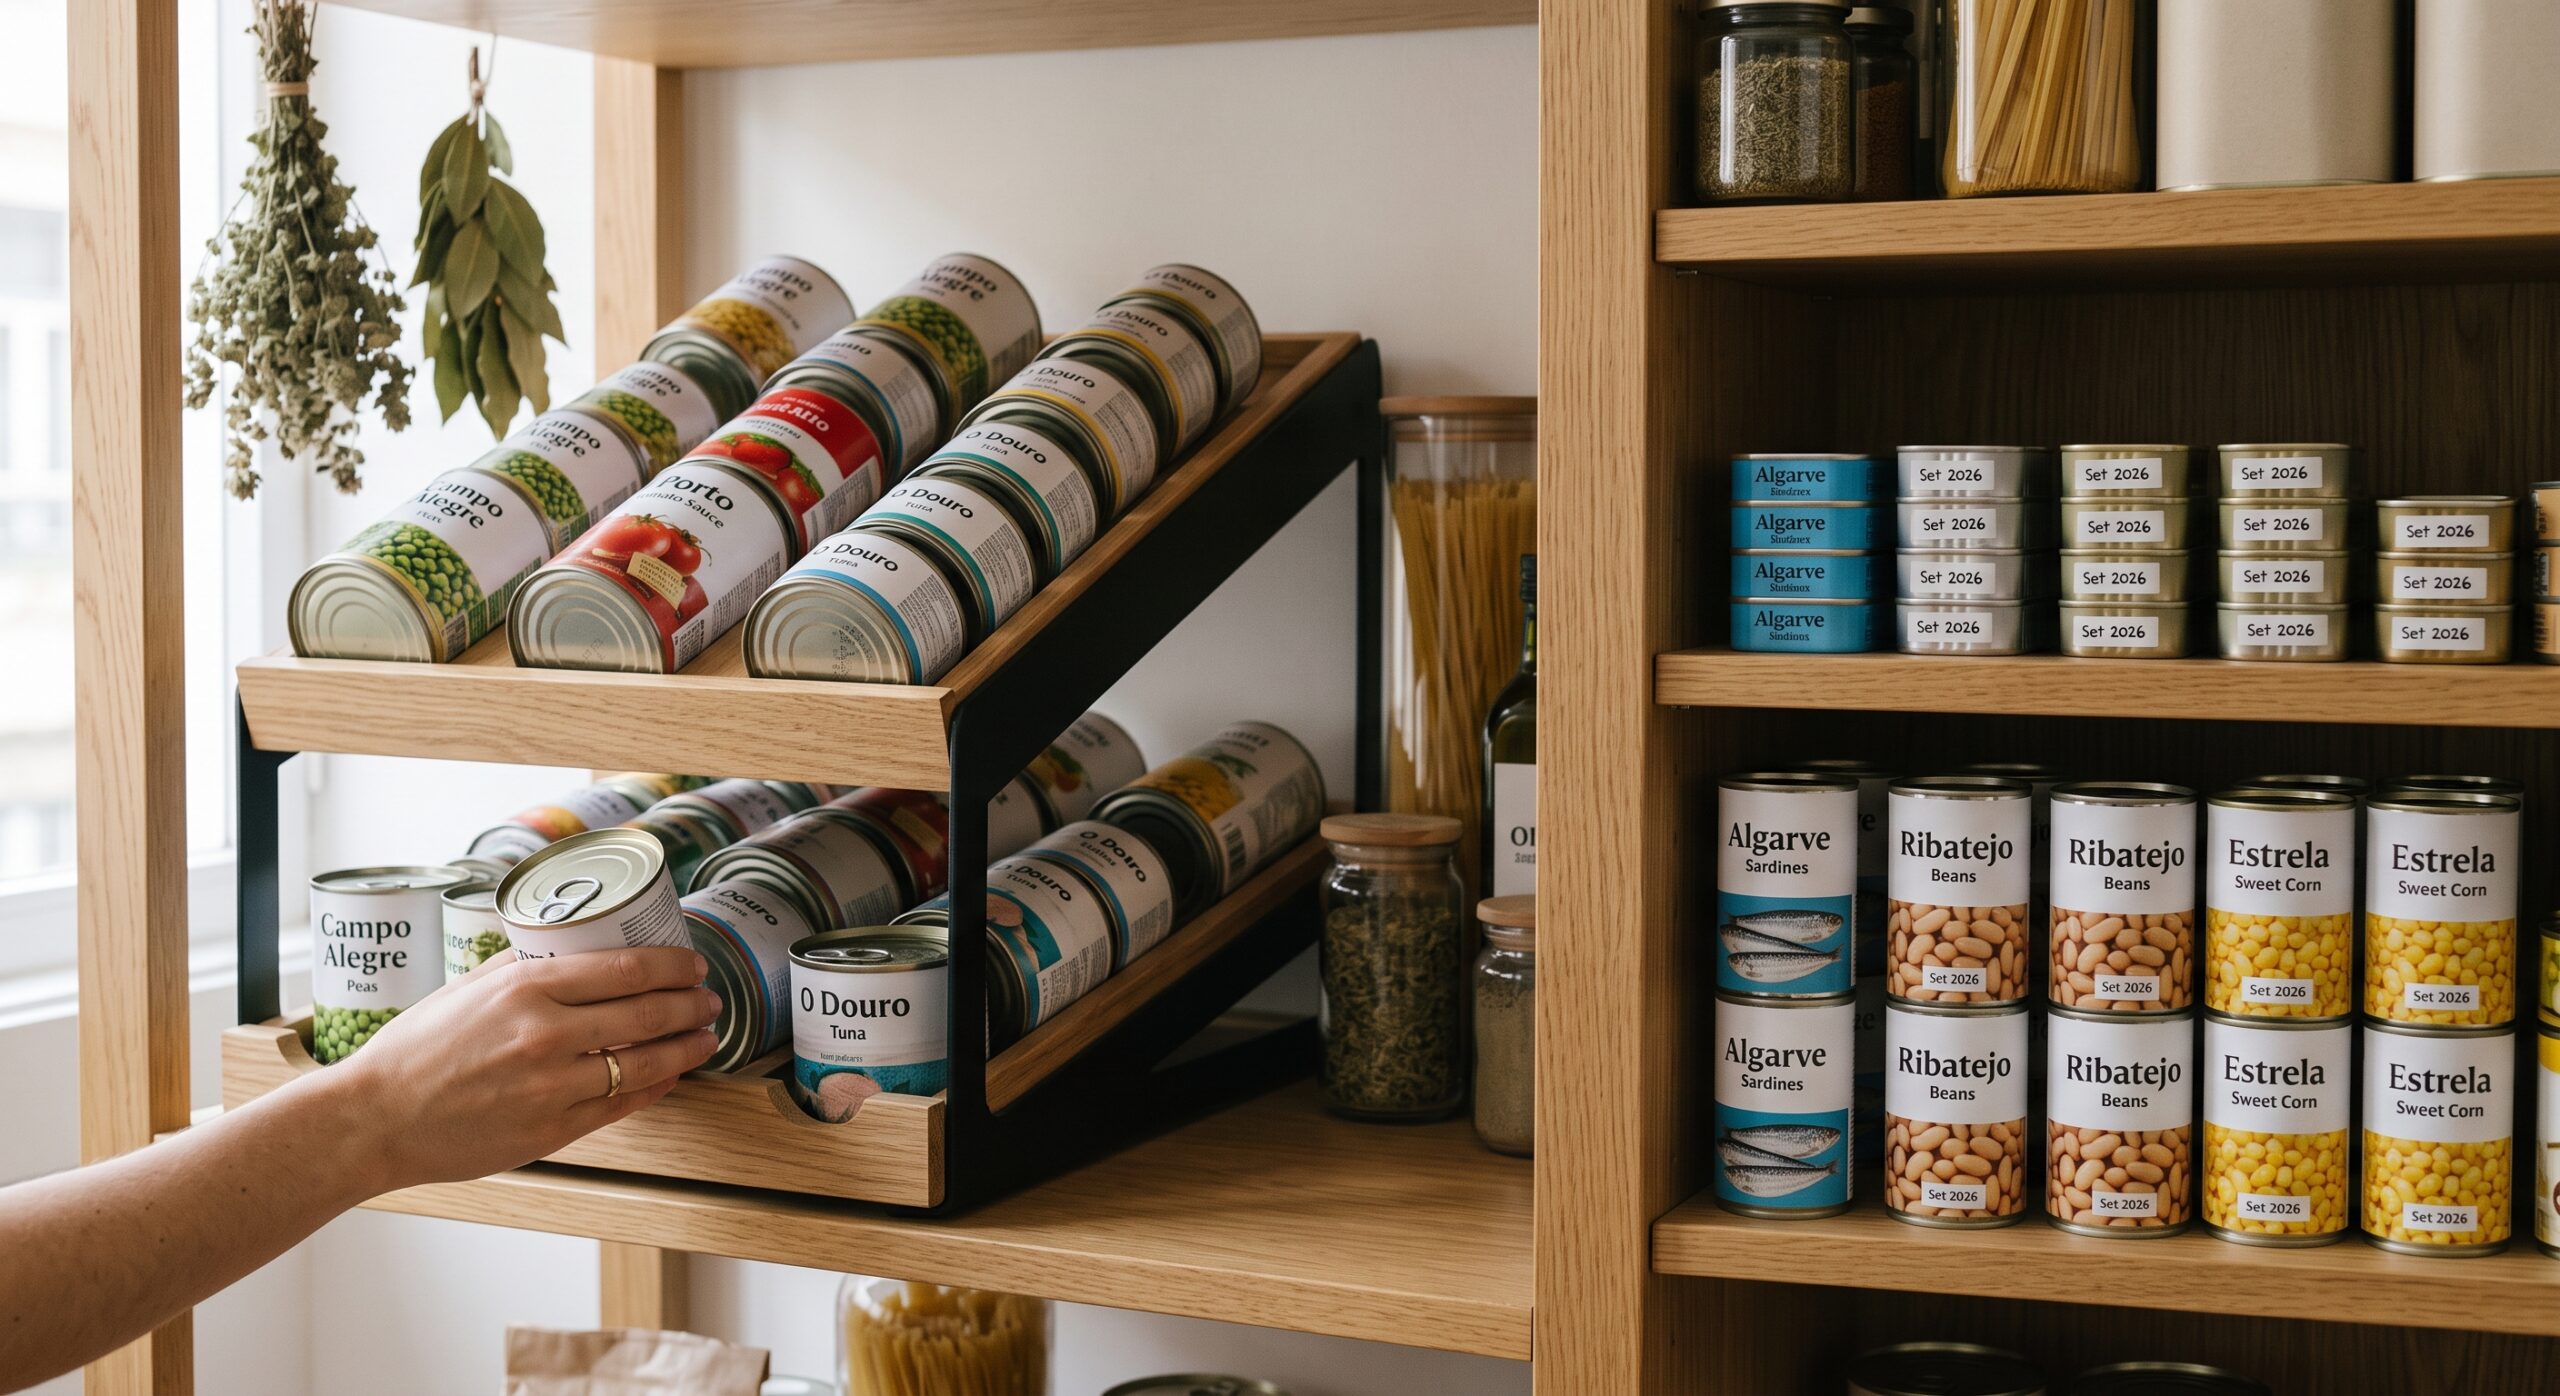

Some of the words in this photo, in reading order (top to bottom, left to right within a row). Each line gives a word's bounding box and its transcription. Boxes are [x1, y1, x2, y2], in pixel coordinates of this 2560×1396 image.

[1162, 271, 1217, 300] Douro
[1114, 310, 1169, 337] Douro
[1038, 367, 1096, 388] Douro
[966, 431, 982, 439] O
[985, 431, 1047, 464] Douro
[1755, 466, 1826, 487] Algarve
[1919, 468, 1942, 482] Set
[1947, 468, 1983, 482] 2026
[2085, 468, 2108, 482] Set
[2114, 467, 2150, 481] 2026
[2241, 467, 2265, 481] Set
[2271, 465, 2308, 480] 2026
[657, 475, 734, 511] Porto
[891, 489, 908, 498] O
[910, 488, 974, 519] Douro
[684, 499, 725, 529] Sauce
[1755, 513, 1826, 535] Algarve
[1923, 518, 1945, 531] Set
[1951, 517, 1986, 531] 2026
[2087, 520, 2111, 534] Set
[2116, 520, 2151, 534] 2026
[2243, 518, 2267, 532] Set
[2273, 517, 2310, 531] 2026
[2406, 524, 2431, 539] Set
[2436, 524, 2475, 538] 2026
[832, 543, 899, 572] Douro
[1754, 562, 1826, 583] Algarve
[1920, 570, 1943, 584] Set
[1948, 571, 1983, 585] 2026
[2083, 571, 2106, 585] Set
[2111, 571, 2147, 585] 2026
[2243, 569, 2268, 584] Set
[2273, 569, 2311, 584] 2026
[2403, 575, 2428, 589] Set
[2433, 576, 2472, 590] 2026
[1754, 610, 1825, 631] Algarve
[1916, 620, 1940, 634] Set
[1945, 620, 1980, 634] 2026
[2082, 624, 2105, 638] Set
[2110, 625, 2146, 639] 2026
[2247, 623, 2272, 637] Set
[2277, 623, 2315, 637] 2026
[2401, 626, 2426, 640] Set
[2431, 626, 2470, 641] 2026
[1079, 830, 1098, 840] O
[1728, 822, 1831, 856] Algarve
[1900, 830, 2014, 867] Ribatejo
[2069, 838, 2185, 875] Ribatejo
[2229, 838, 2330, 869] Estrela
[1745, 858, 1809, 875] Sardines
[2392, 843, 2497, 874] Estrela
[1014, 864, 1072, 902] Douro
[1931, 868, 1977, 883] Beans
[2104, 876, 2151, 891] Beans
[2235, 874, 2282, 892] Sweet
[2285, 877, 2322, 892] Corn
[2398, 880, 2447, 897] Sweet
[2450, 883, 2487, 897] Corn
[718, 889, 778, 926] Douro
[320, 912, 412, 943] Campo
[323, 943, 408, 975] Alegre
[346, 979, 379, 993] Peas
[1929, 972, 1948, 985] Set
[1950, 973, 1980, 985] 2026
[2102, 981, 2121, 993] Set
[2124, 982, 2153, 994] 2026
[2249, 984, 2271, 997] Set
[2274, 986, 2307, 998] 2026
[820, 989, 911, 1019] Douro
[2413, 990, 2434, 1003] Set
[2438, 991, 2471, 1004] 2026
[829, 1024, 867, 1041] Tuna
[1725, 1037, 1827, 1072] Algarve
[1898, 1046, 2012, 1085] Ribatejo
[2067, 1054, 2182, 1092] Ribatejo
[2224, 1054, 2326, 1086] Estrela
[1741, 1073, 1804, 1091] Sardines
[2389, 1063, 2492, 1095] Estrela
[1930, 1085, 1976, 1101] Beans
[2101, 1093, 2149, 1108] Beans
[2231, 1090, 2278, 1109] Sweet
[2281, 1094, 2318, 1109] Corn
[2396, 1100, 2445, 1118] Sweet
[2448, 1103, 2484, 1118] Corn
[1928, 1189, 1947, 1201] Set
[1949, 1190, 1978, 1202] 2026
[2100, 1198, 2119, 1210] Set
[2121, 1199, 2150, 1210] 2026
[2246, 1200, 2266, 1214] Set
[2269, 1202, 2301, 1215] 2026
[2412, 1210, 2433, 1224] Set
[2436, 1212, 2468, 1225] 2026
